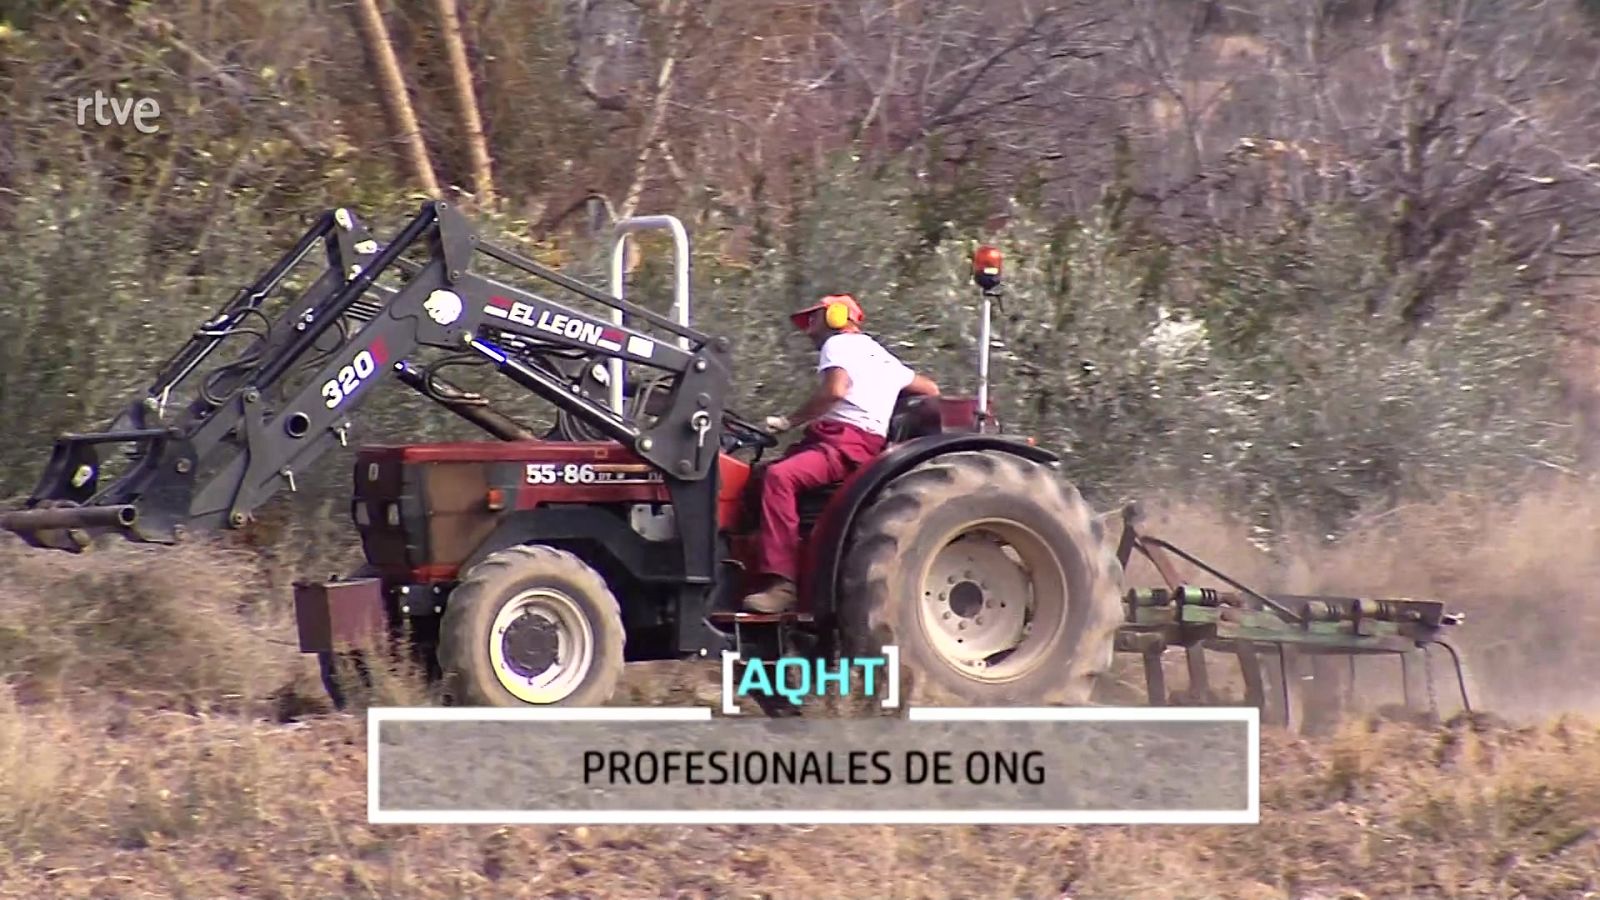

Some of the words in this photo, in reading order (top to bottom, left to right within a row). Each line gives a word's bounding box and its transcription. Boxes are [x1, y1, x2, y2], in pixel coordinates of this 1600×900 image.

[507, 301, 536, 327] EL
[537, 310, 604, 345] LEON
[322, 350, 375, 409] 320
[526, 464, 596, 484] 55-86
